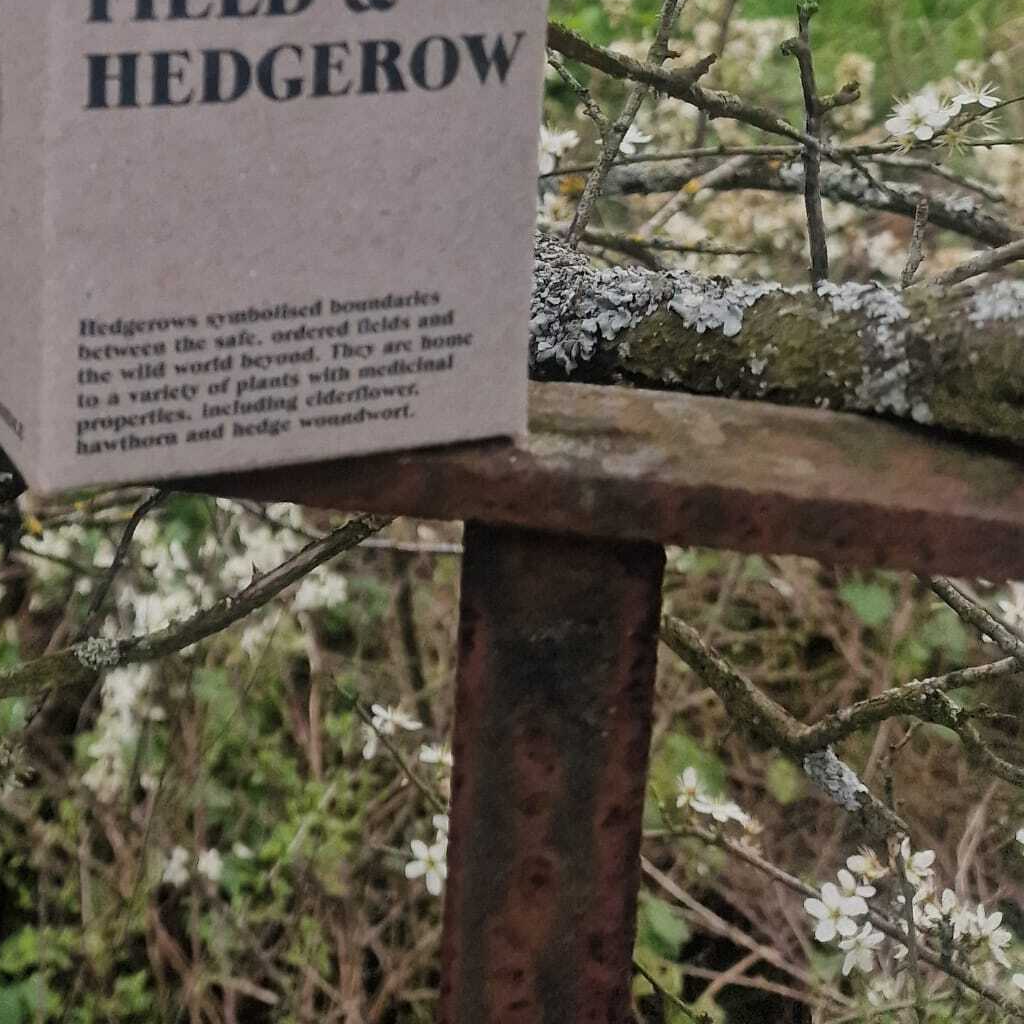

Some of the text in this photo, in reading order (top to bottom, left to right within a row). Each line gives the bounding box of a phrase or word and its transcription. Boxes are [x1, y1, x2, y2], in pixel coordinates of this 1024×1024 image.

[85, 31, 526, 110] HEDGEROW
[78, 342, 166, 361] between
[175, 336, 207, 353] the
[271, 321, 350, 343] ordered
[357, 315, 410, 335] fields
[418, 310, 454, 329] and
[79, 290, 440, 339] Hedgerows symbolised boundaries
[77, 366, 112, 385] the
[121, 362, 165, 381] wild
[174, 356, 233, 375] world
[331, 343, 374, 361] They
[383, 339, 412, 354] are
[420, 332, 473, 351] home
[77, 356, 453, 409] to a variety of plants with medicinal
[202, 394, 298, 419] including
[76, 431, 178, 455] hawthorn
[186, 424, 224, 443] and
[232, 418, 291, 440] hedge
